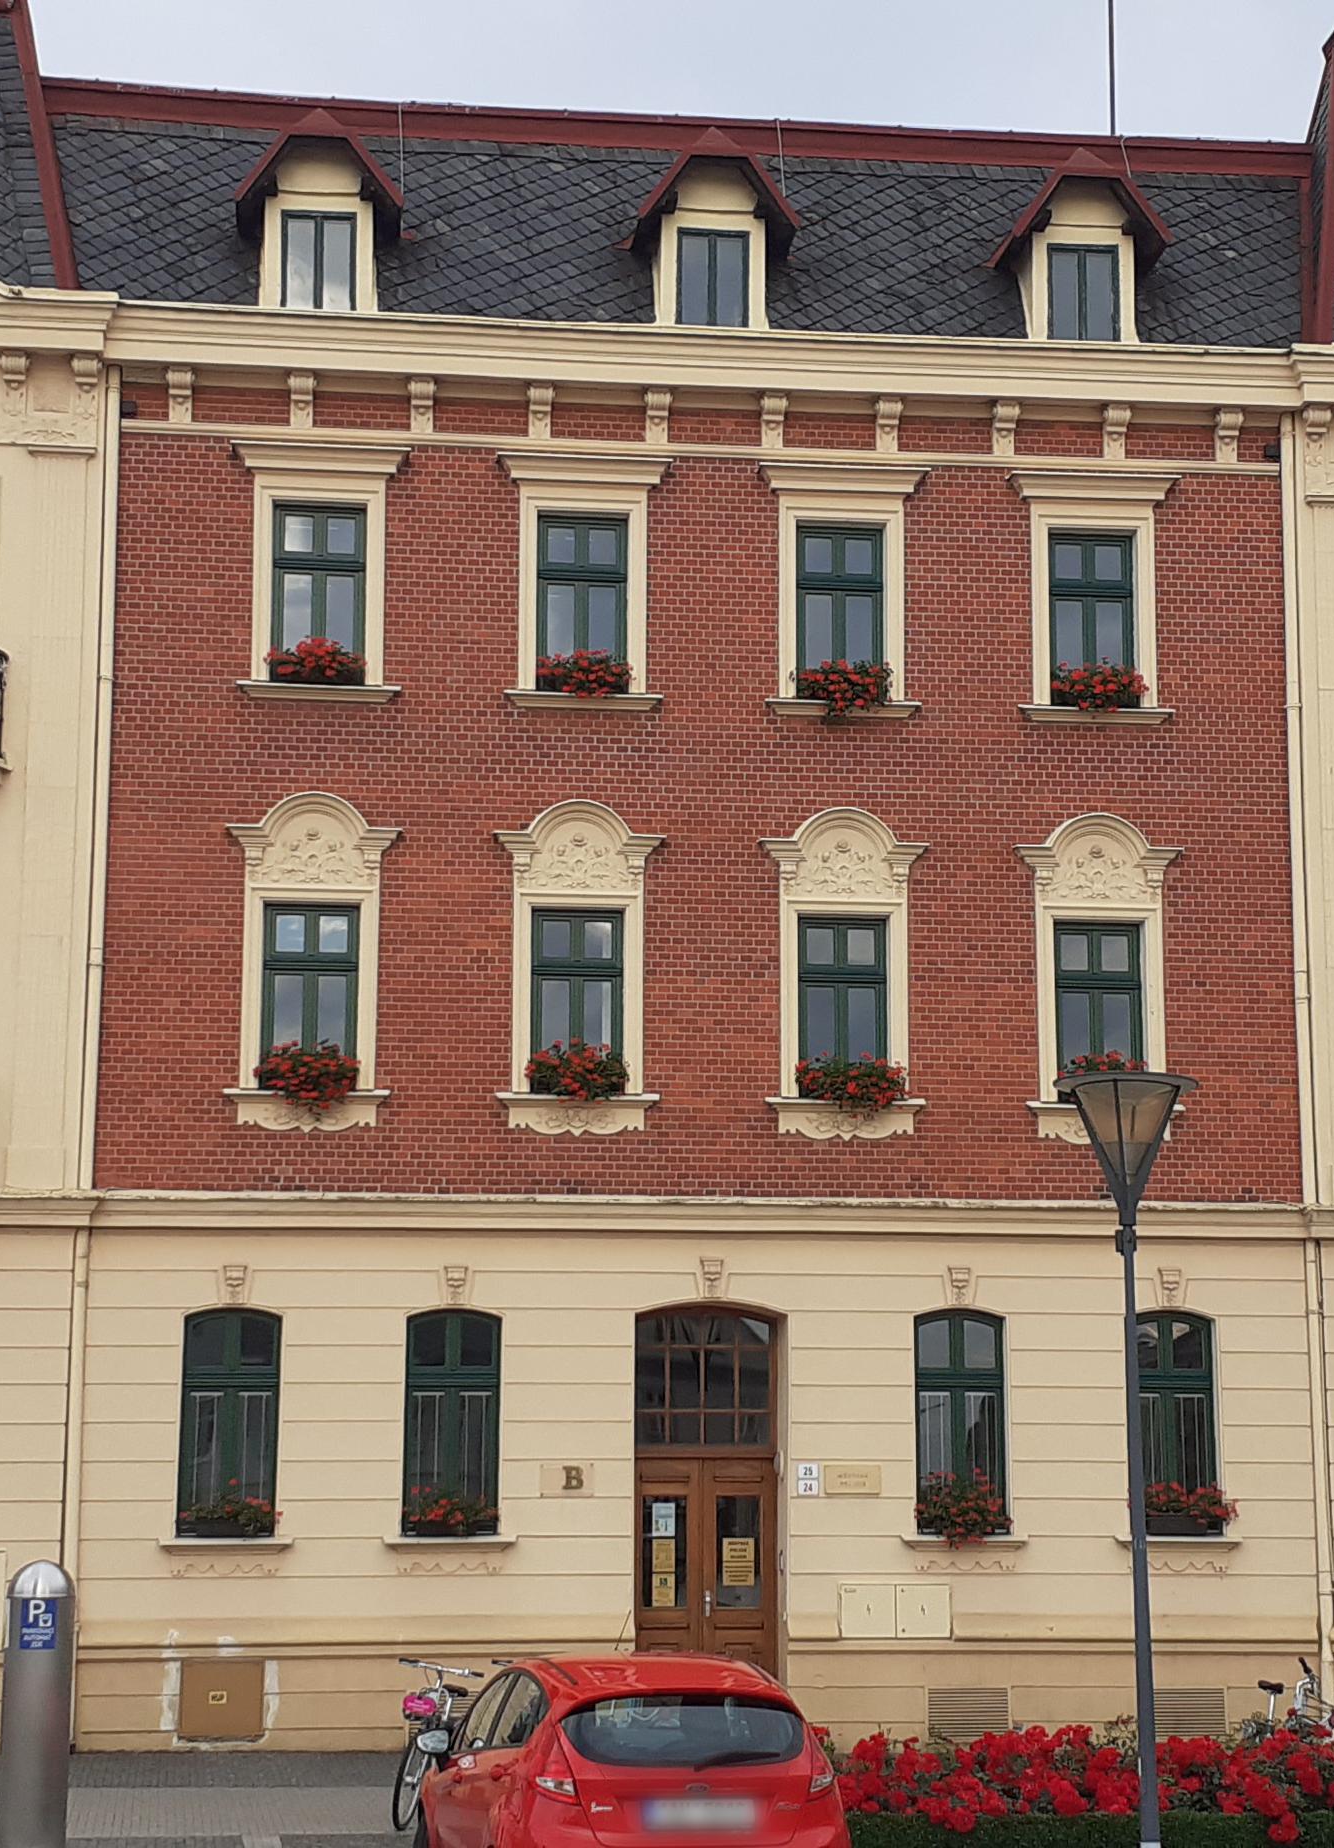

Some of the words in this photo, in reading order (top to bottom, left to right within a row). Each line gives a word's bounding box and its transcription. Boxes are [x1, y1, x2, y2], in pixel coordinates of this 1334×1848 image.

[561, 1464, 585, 1490] B
[803, 1465, 814, 1477] 25
[803, 1482, 814, 1493] 24
[28, 1599, 46, 1624] P
